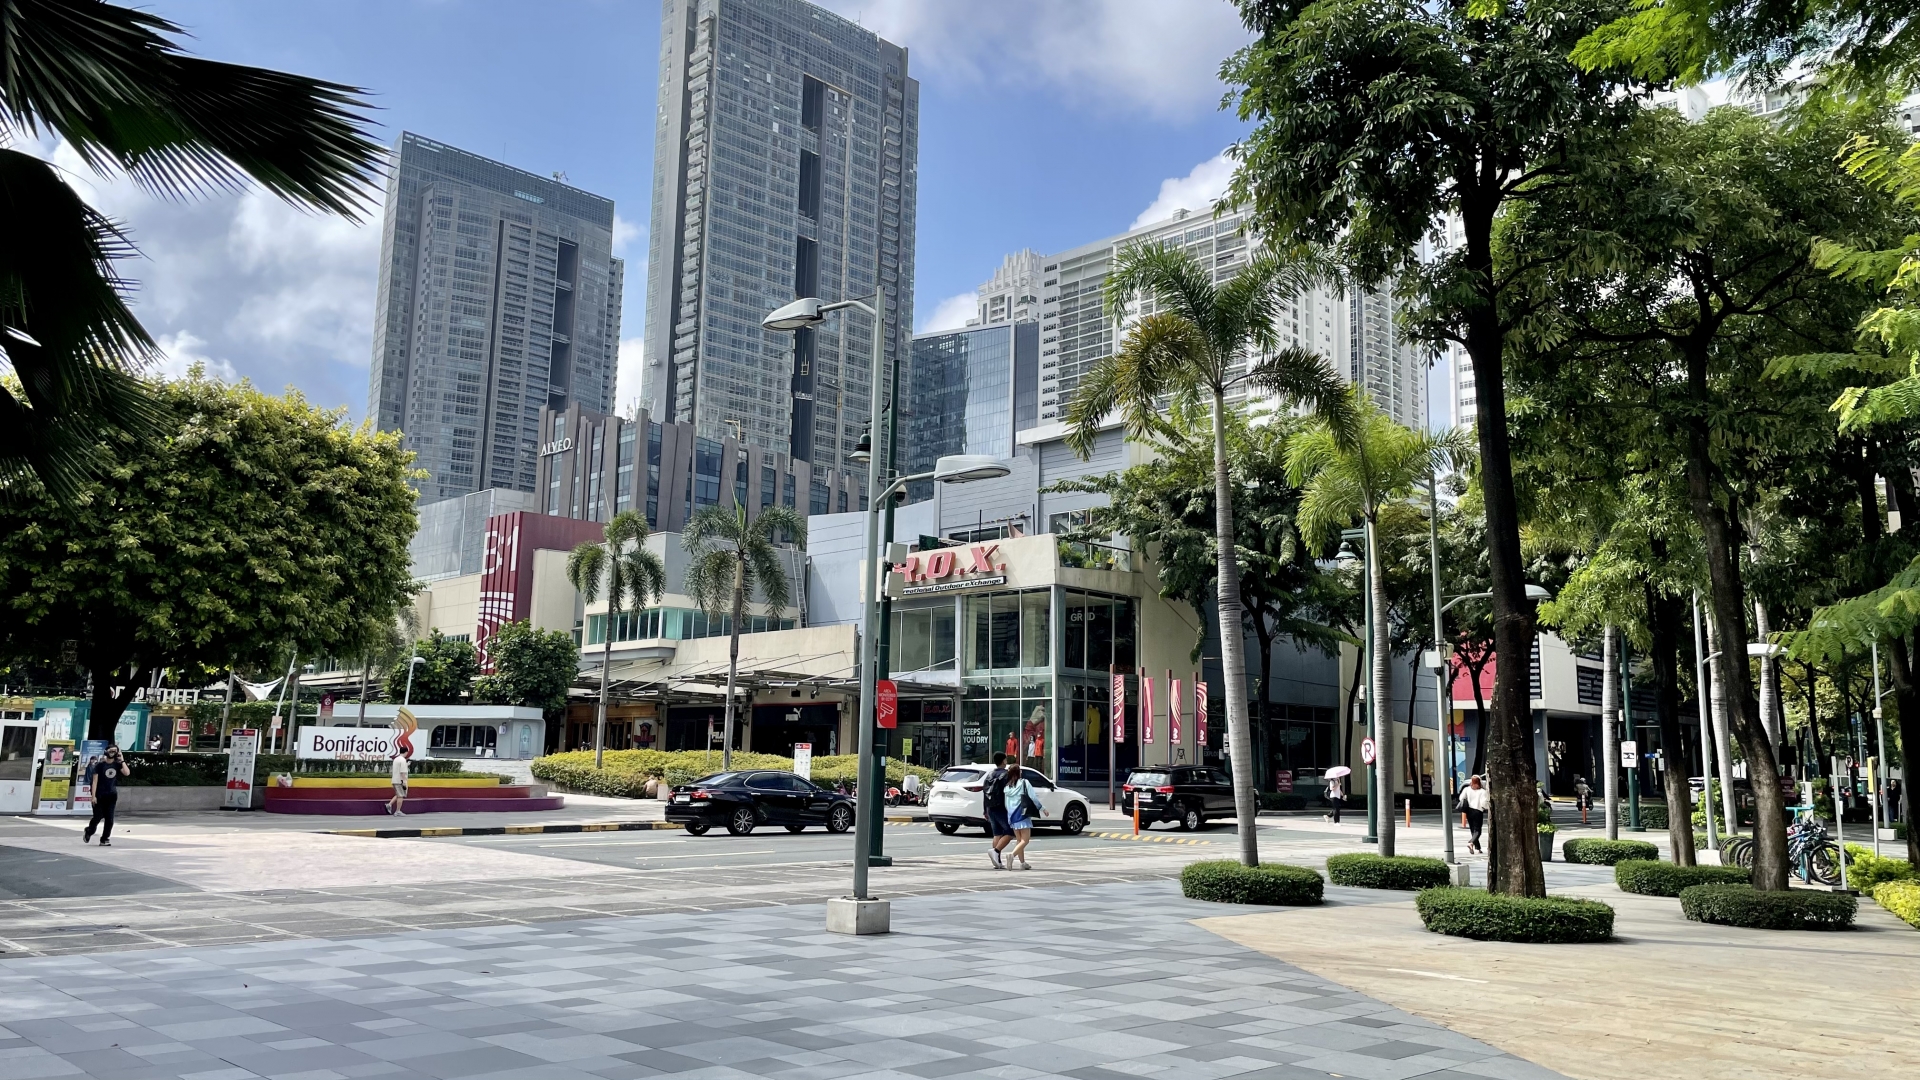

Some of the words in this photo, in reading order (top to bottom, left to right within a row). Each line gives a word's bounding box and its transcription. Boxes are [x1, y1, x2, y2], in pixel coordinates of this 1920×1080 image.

[540, 437, 574, 457] ALVEO
[903, 585, 934, 594] reational
[935, 583, 964, 591] Outdoor
[964, 579, 1001, 587] eXchange
[963, 728, 981, 736] KEEPS
[313, 735, 388, 753] Bonifacio
[963, 736, 976, 744] YOU
[976, 736, 989, 744] DRY
[335, 751, 355, 760] High
[358, 752, 385, 760] Street
[1060, 766, 1082, 774] HYDRAULIC
